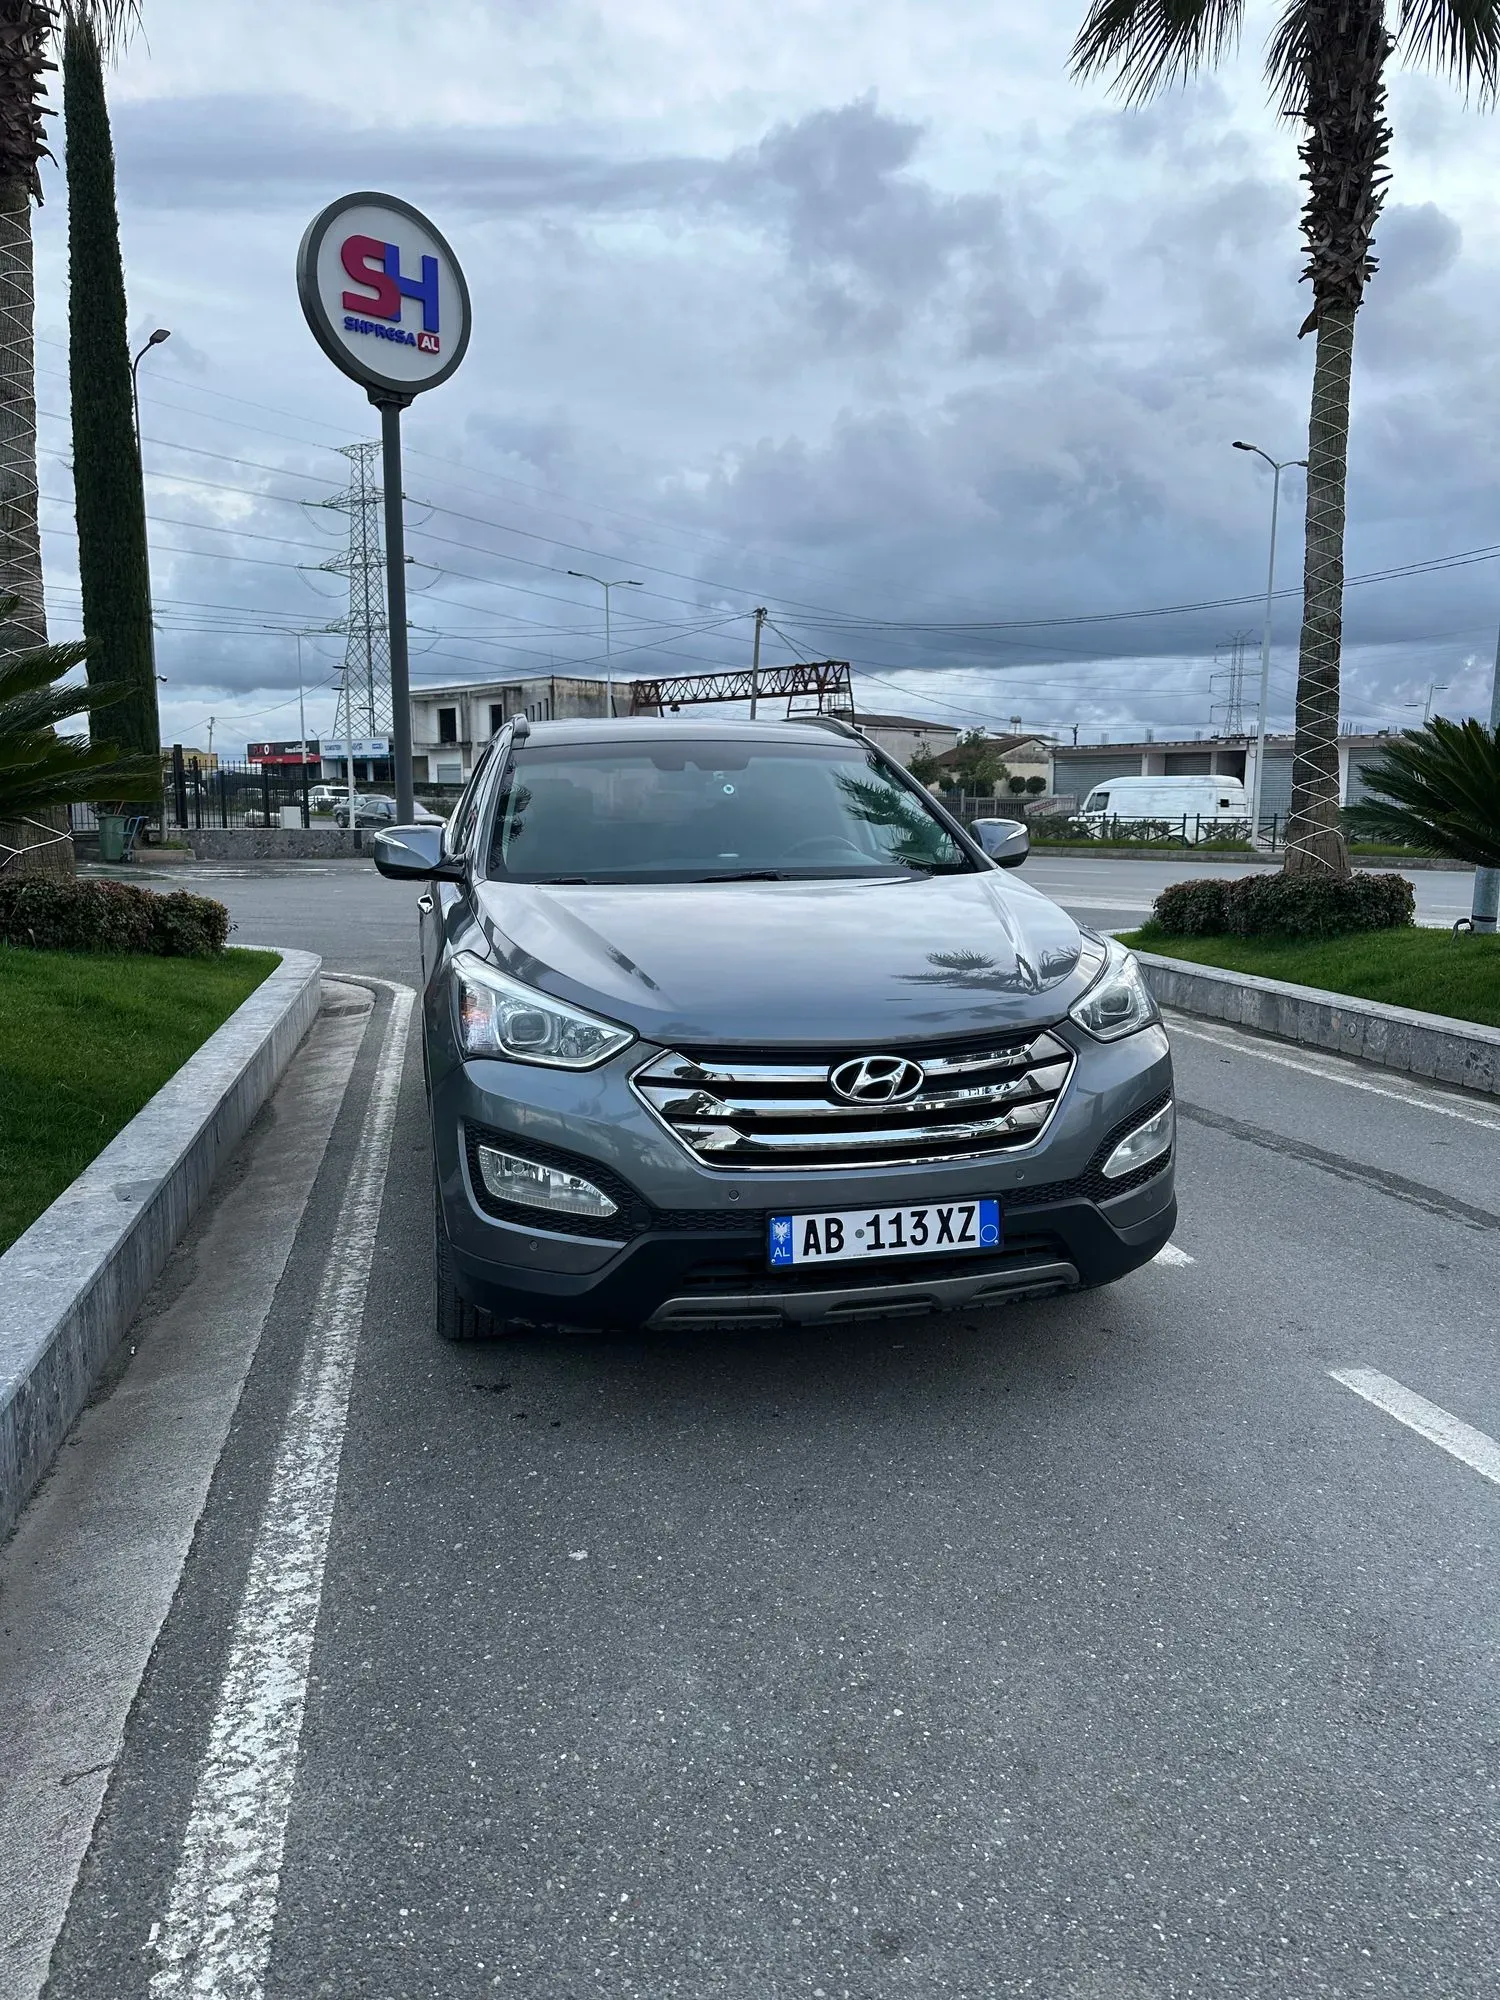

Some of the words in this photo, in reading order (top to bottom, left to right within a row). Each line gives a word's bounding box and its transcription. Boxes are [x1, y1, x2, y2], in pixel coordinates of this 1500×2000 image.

[340, 234, 439, 333] SH
[421, 336, 439, 351] AL
[803, 1218, 845, 1256] AB
[773, 1246, 791, 1258] AL
